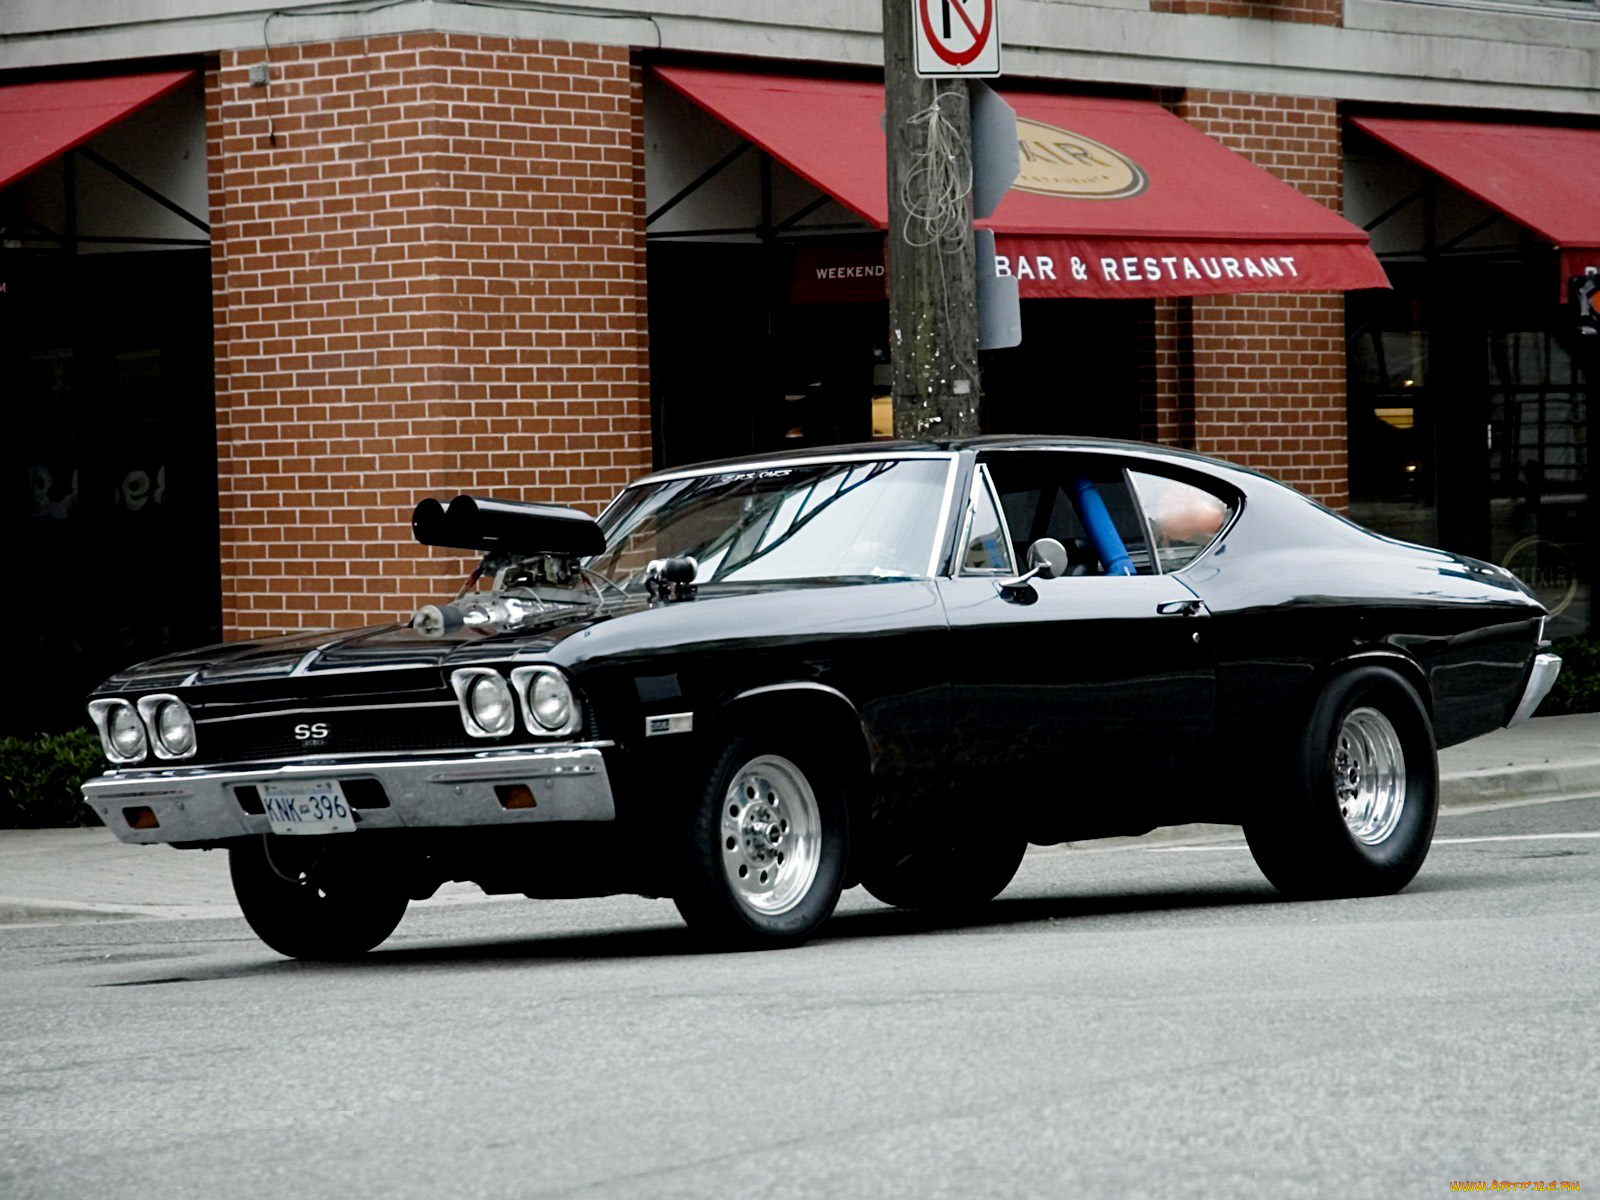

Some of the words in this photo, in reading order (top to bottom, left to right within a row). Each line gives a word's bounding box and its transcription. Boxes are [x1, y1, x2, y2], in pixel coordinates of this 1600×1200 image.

[816, 265, 885, 279] WEEKEND
[995, 255, 1056, 280] BAR
[1070, 256, 1088, 281] &
[1100, 256, 1298, 282] RESTAURANT
[294, 723, 329, 740] SS
